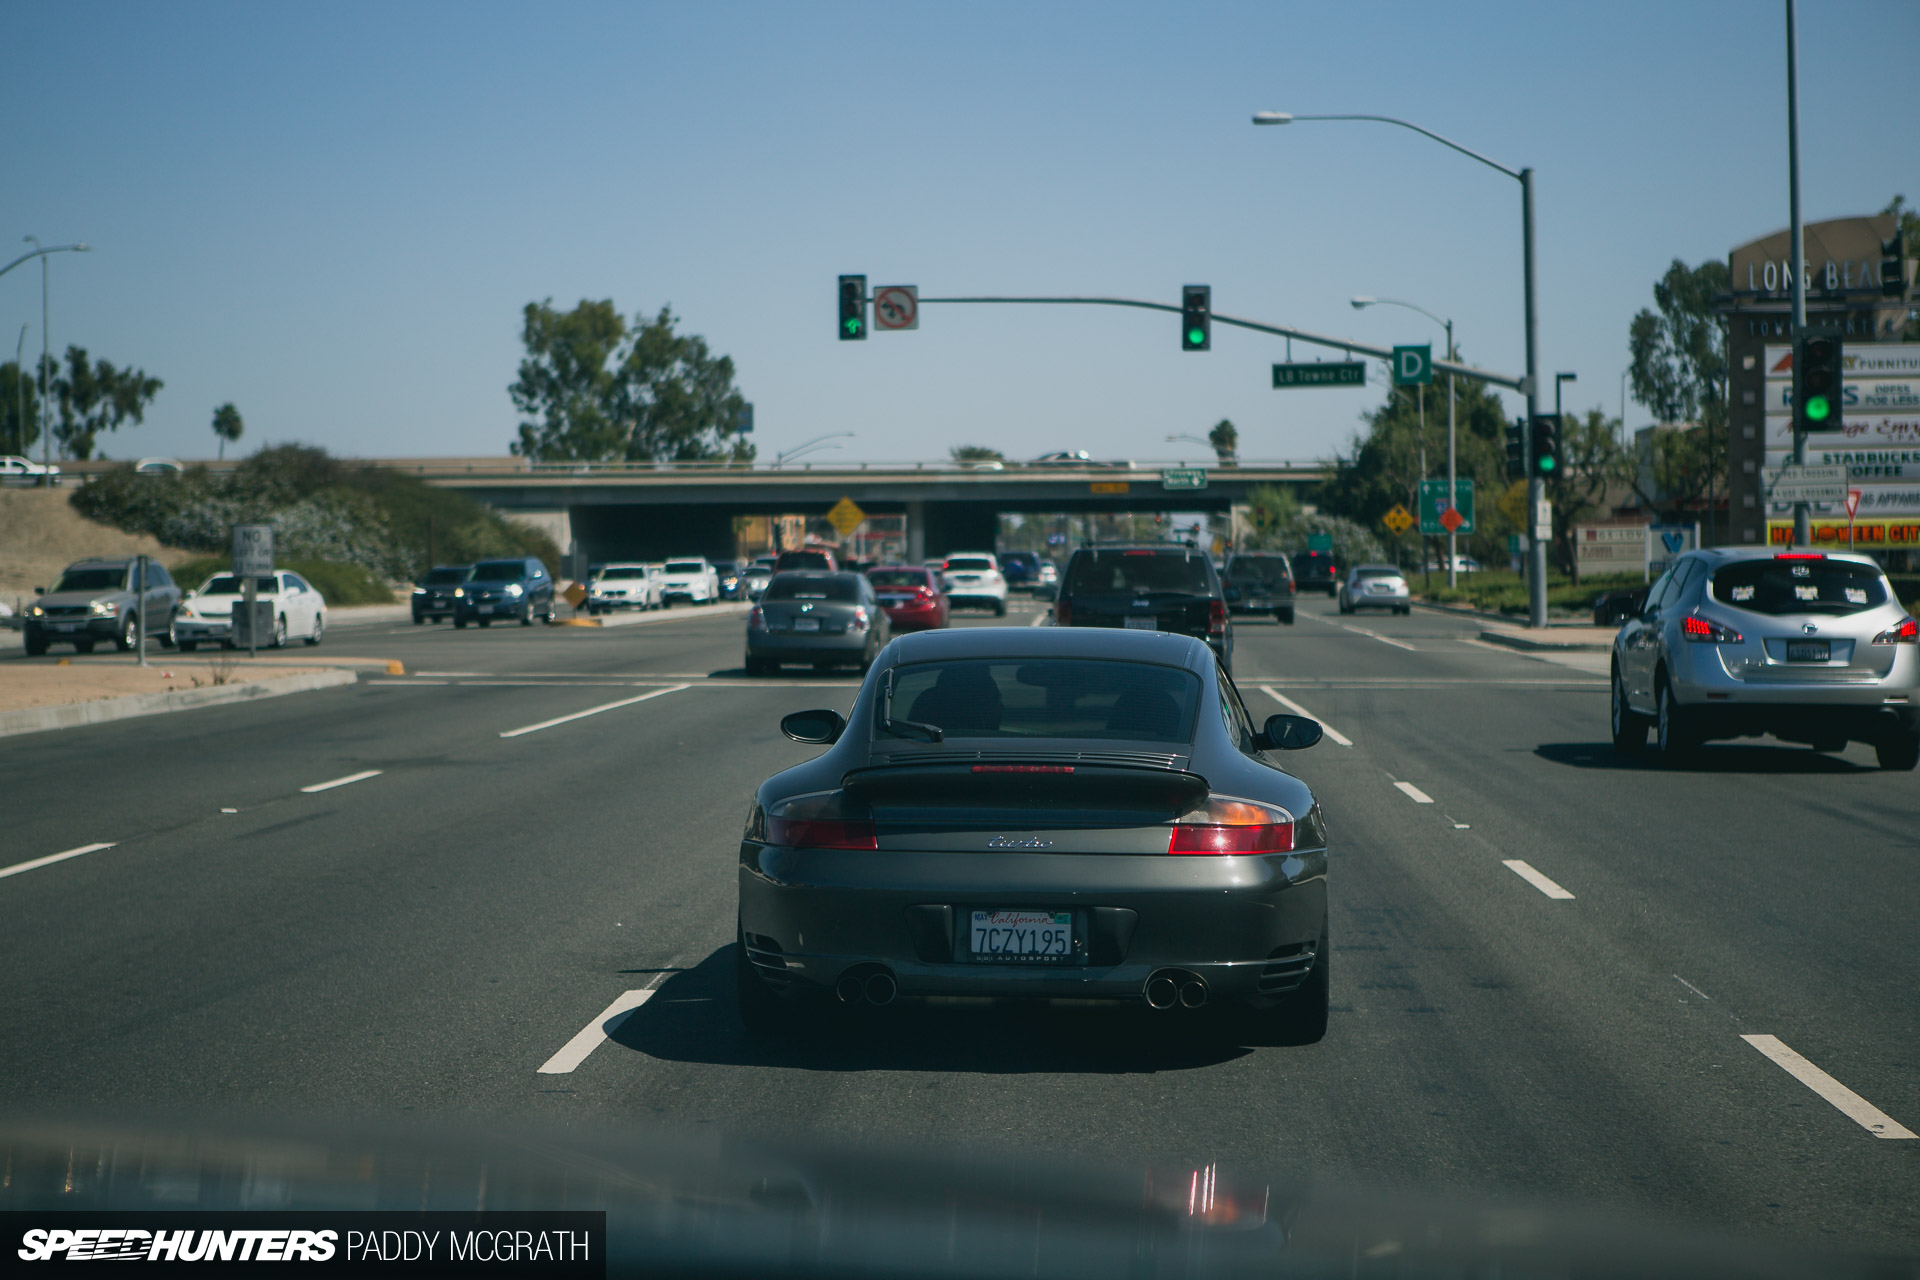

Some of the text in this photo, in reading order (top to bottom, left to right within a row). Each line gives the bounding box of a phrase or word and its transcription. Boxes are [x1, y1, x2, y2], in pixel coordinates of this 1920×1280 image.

[1401, 351, 1423, 378] D
[1279, 369, 1294, 382] LB
[1866, 395, 1889, 406] FOR
[1823, 451, 1920, 465] STARBUCKS
[1802, 469, 1839, 479] CROSSING
[1849, 465, 1903, 477] OFFEE
[1801, 487, 1843, 497] CROSSWALK
[243, 530, 261, 543] NO
[987, 835, 1052, 849] turbo
[974, 913, 988, 921] MAY
[990, 911, 1055, 928] California
[976, 928, 1066, 954] 7CZY195
